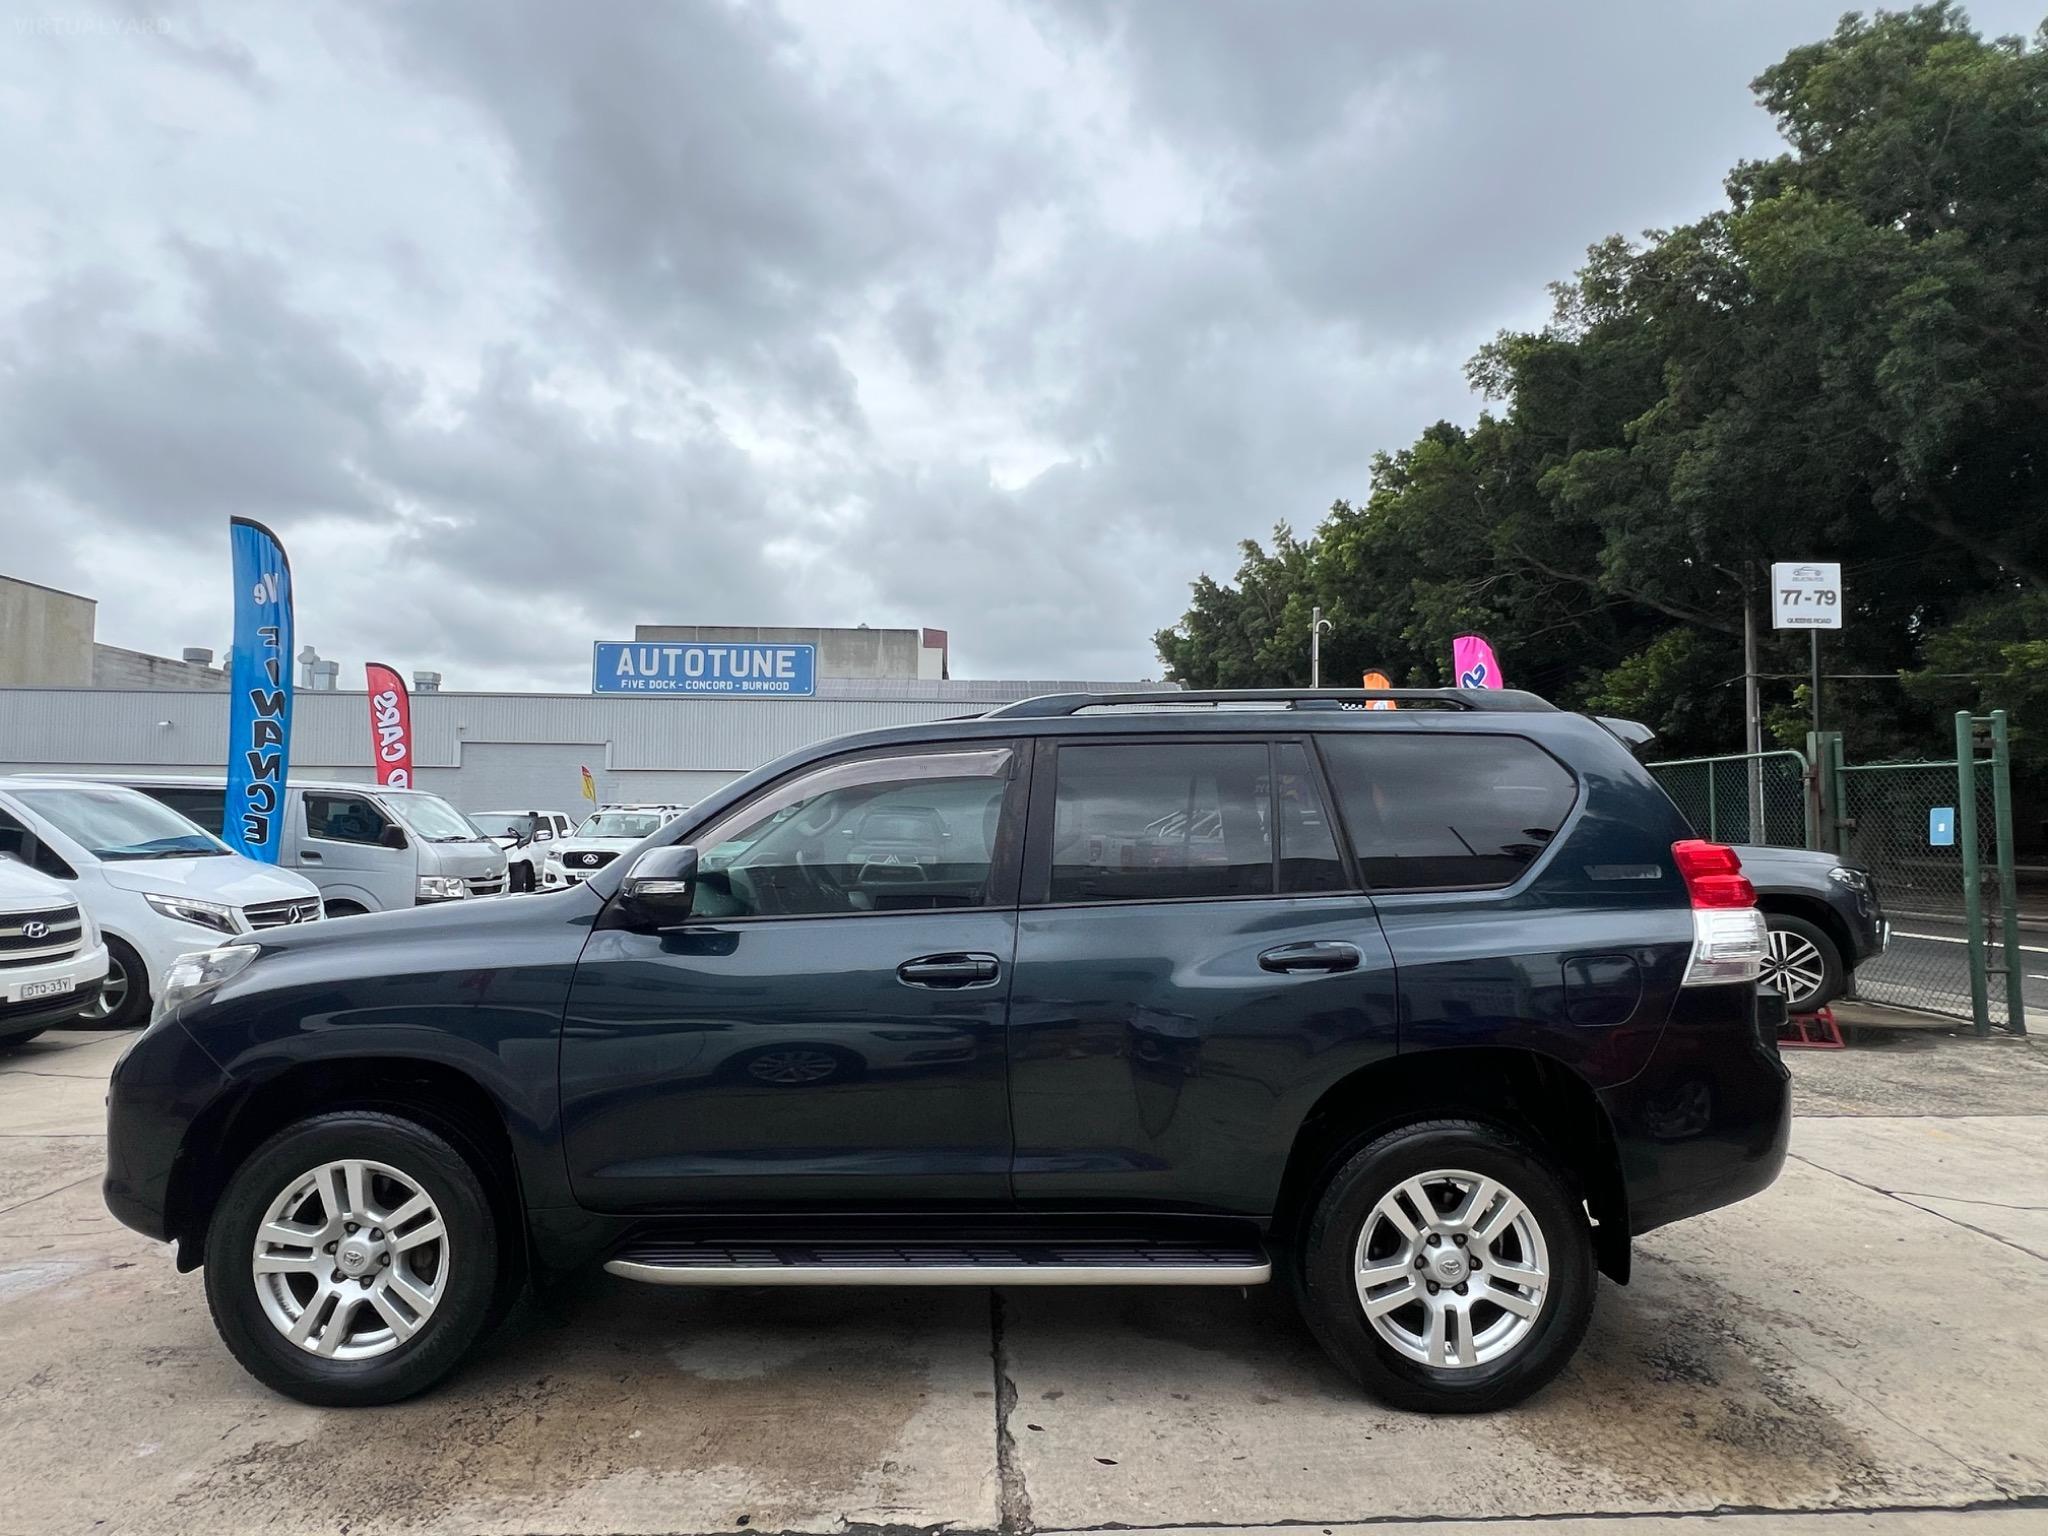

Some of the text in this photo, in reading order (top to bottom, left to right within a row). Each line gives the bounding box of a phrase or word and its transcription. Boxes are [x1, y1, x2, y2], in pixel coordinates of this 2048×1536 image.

[616, 647, 796, 678] AUTOTUNE
[621, 680, 645, 689] FIVE
[649, 680, 676, 690] DOCK
[685, 681, 733, 691] CONCORD
[742, 681, 790, 691] BURWOOD
